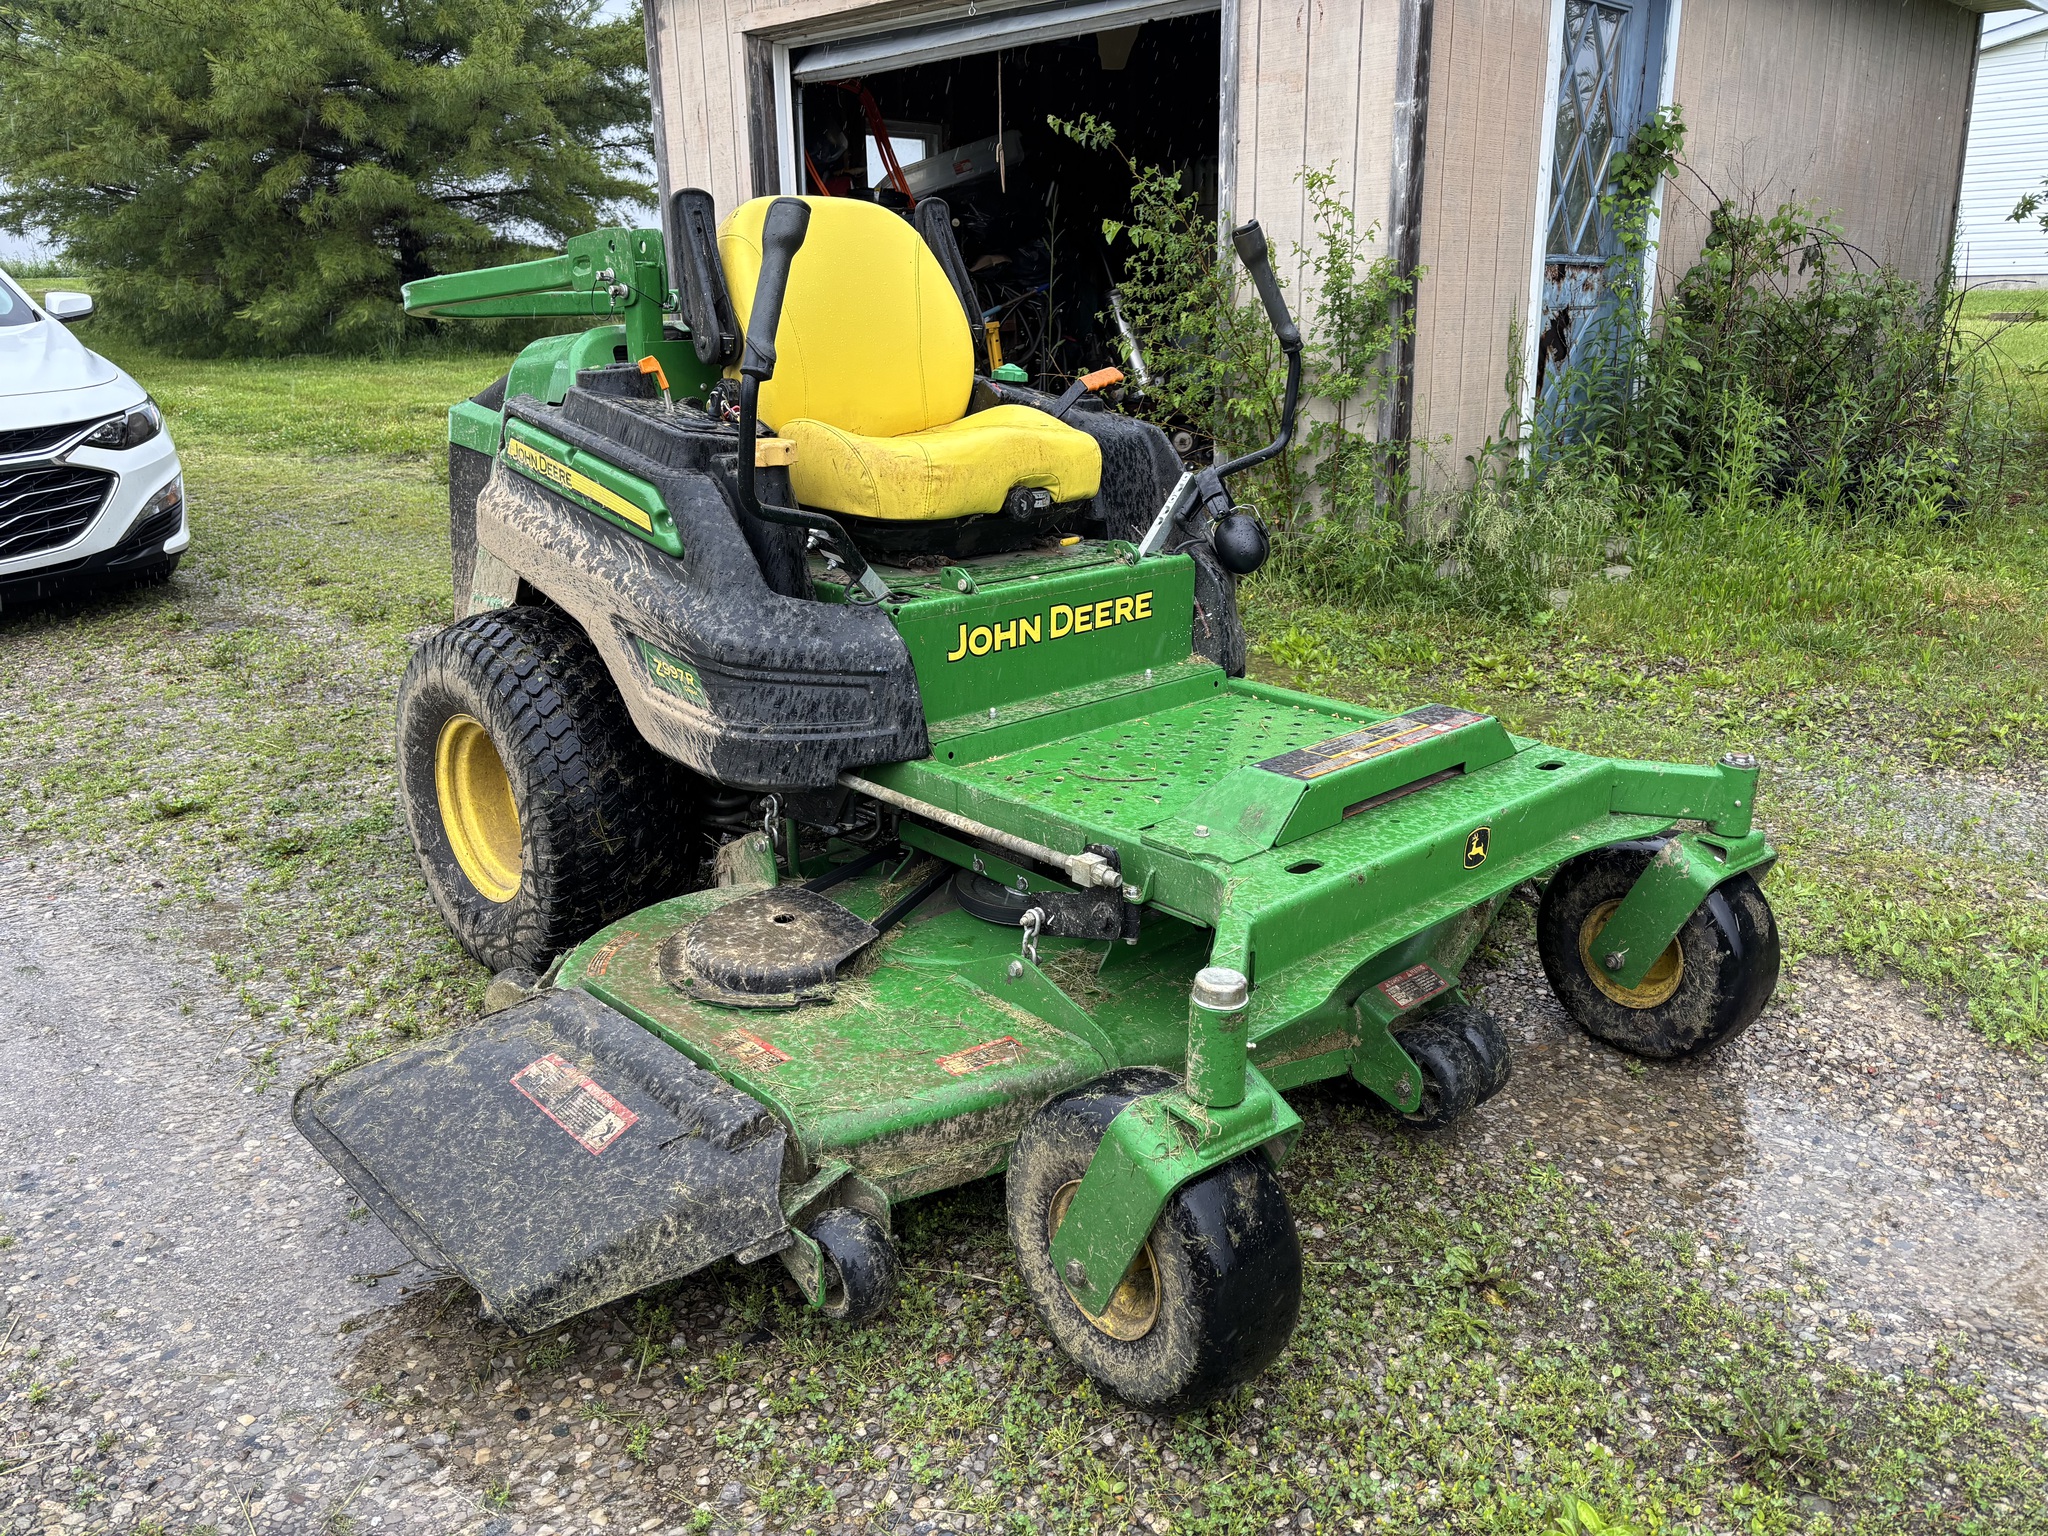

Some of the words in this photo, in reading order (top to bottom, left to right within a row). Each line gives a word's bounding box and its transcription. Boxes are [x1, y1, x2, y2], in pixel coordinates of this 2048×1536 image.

[512, 443, 538, 471] JOHN
[540, 456, 572, 485] DEERE
[947, 613, 1042, 663] JOHN
[1049, 590, 1154, 640] DEERE
